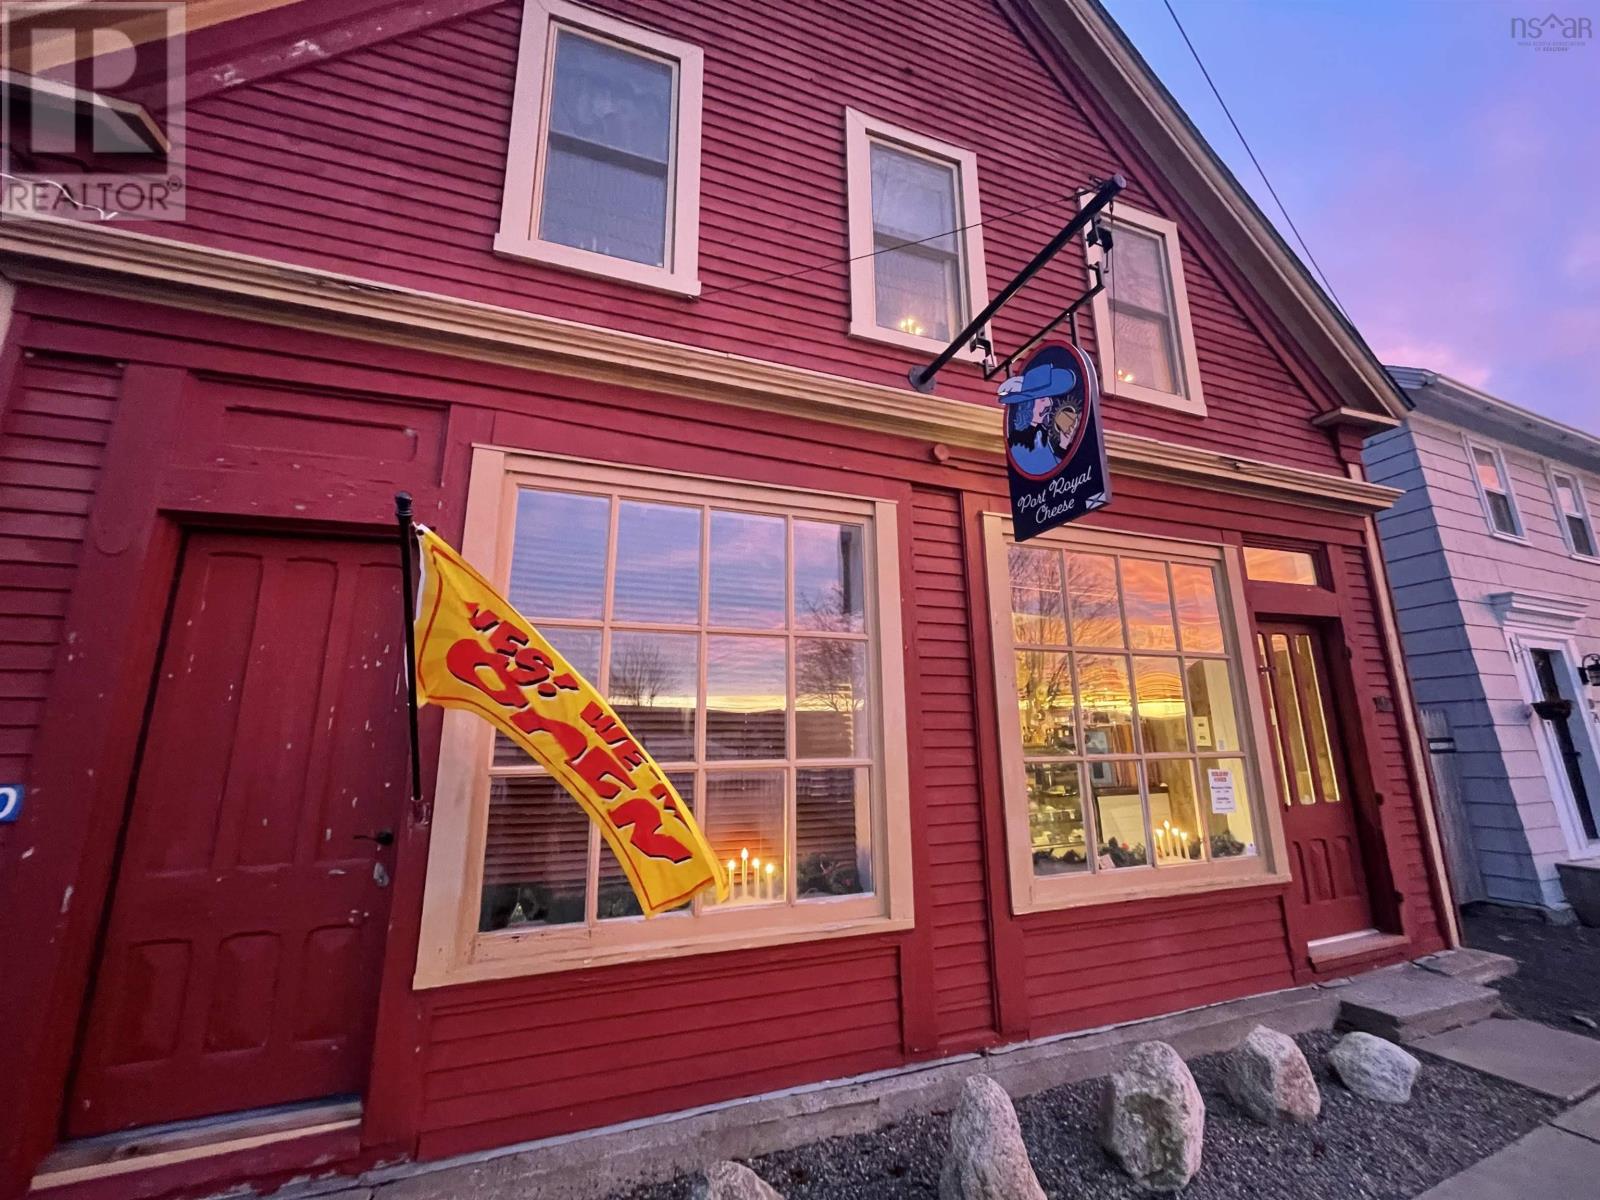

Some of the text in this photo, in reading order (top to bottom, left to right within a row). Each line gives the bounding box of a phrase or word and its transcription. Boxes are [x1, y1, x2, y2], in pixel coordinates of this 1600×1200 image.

[1017, 465, 1092, 513] Port Royal
[1035, 498, 1075, 524] Cheese
[464, 601, 581, 697] YES!
[446, 638, 694, 864] OPEN
